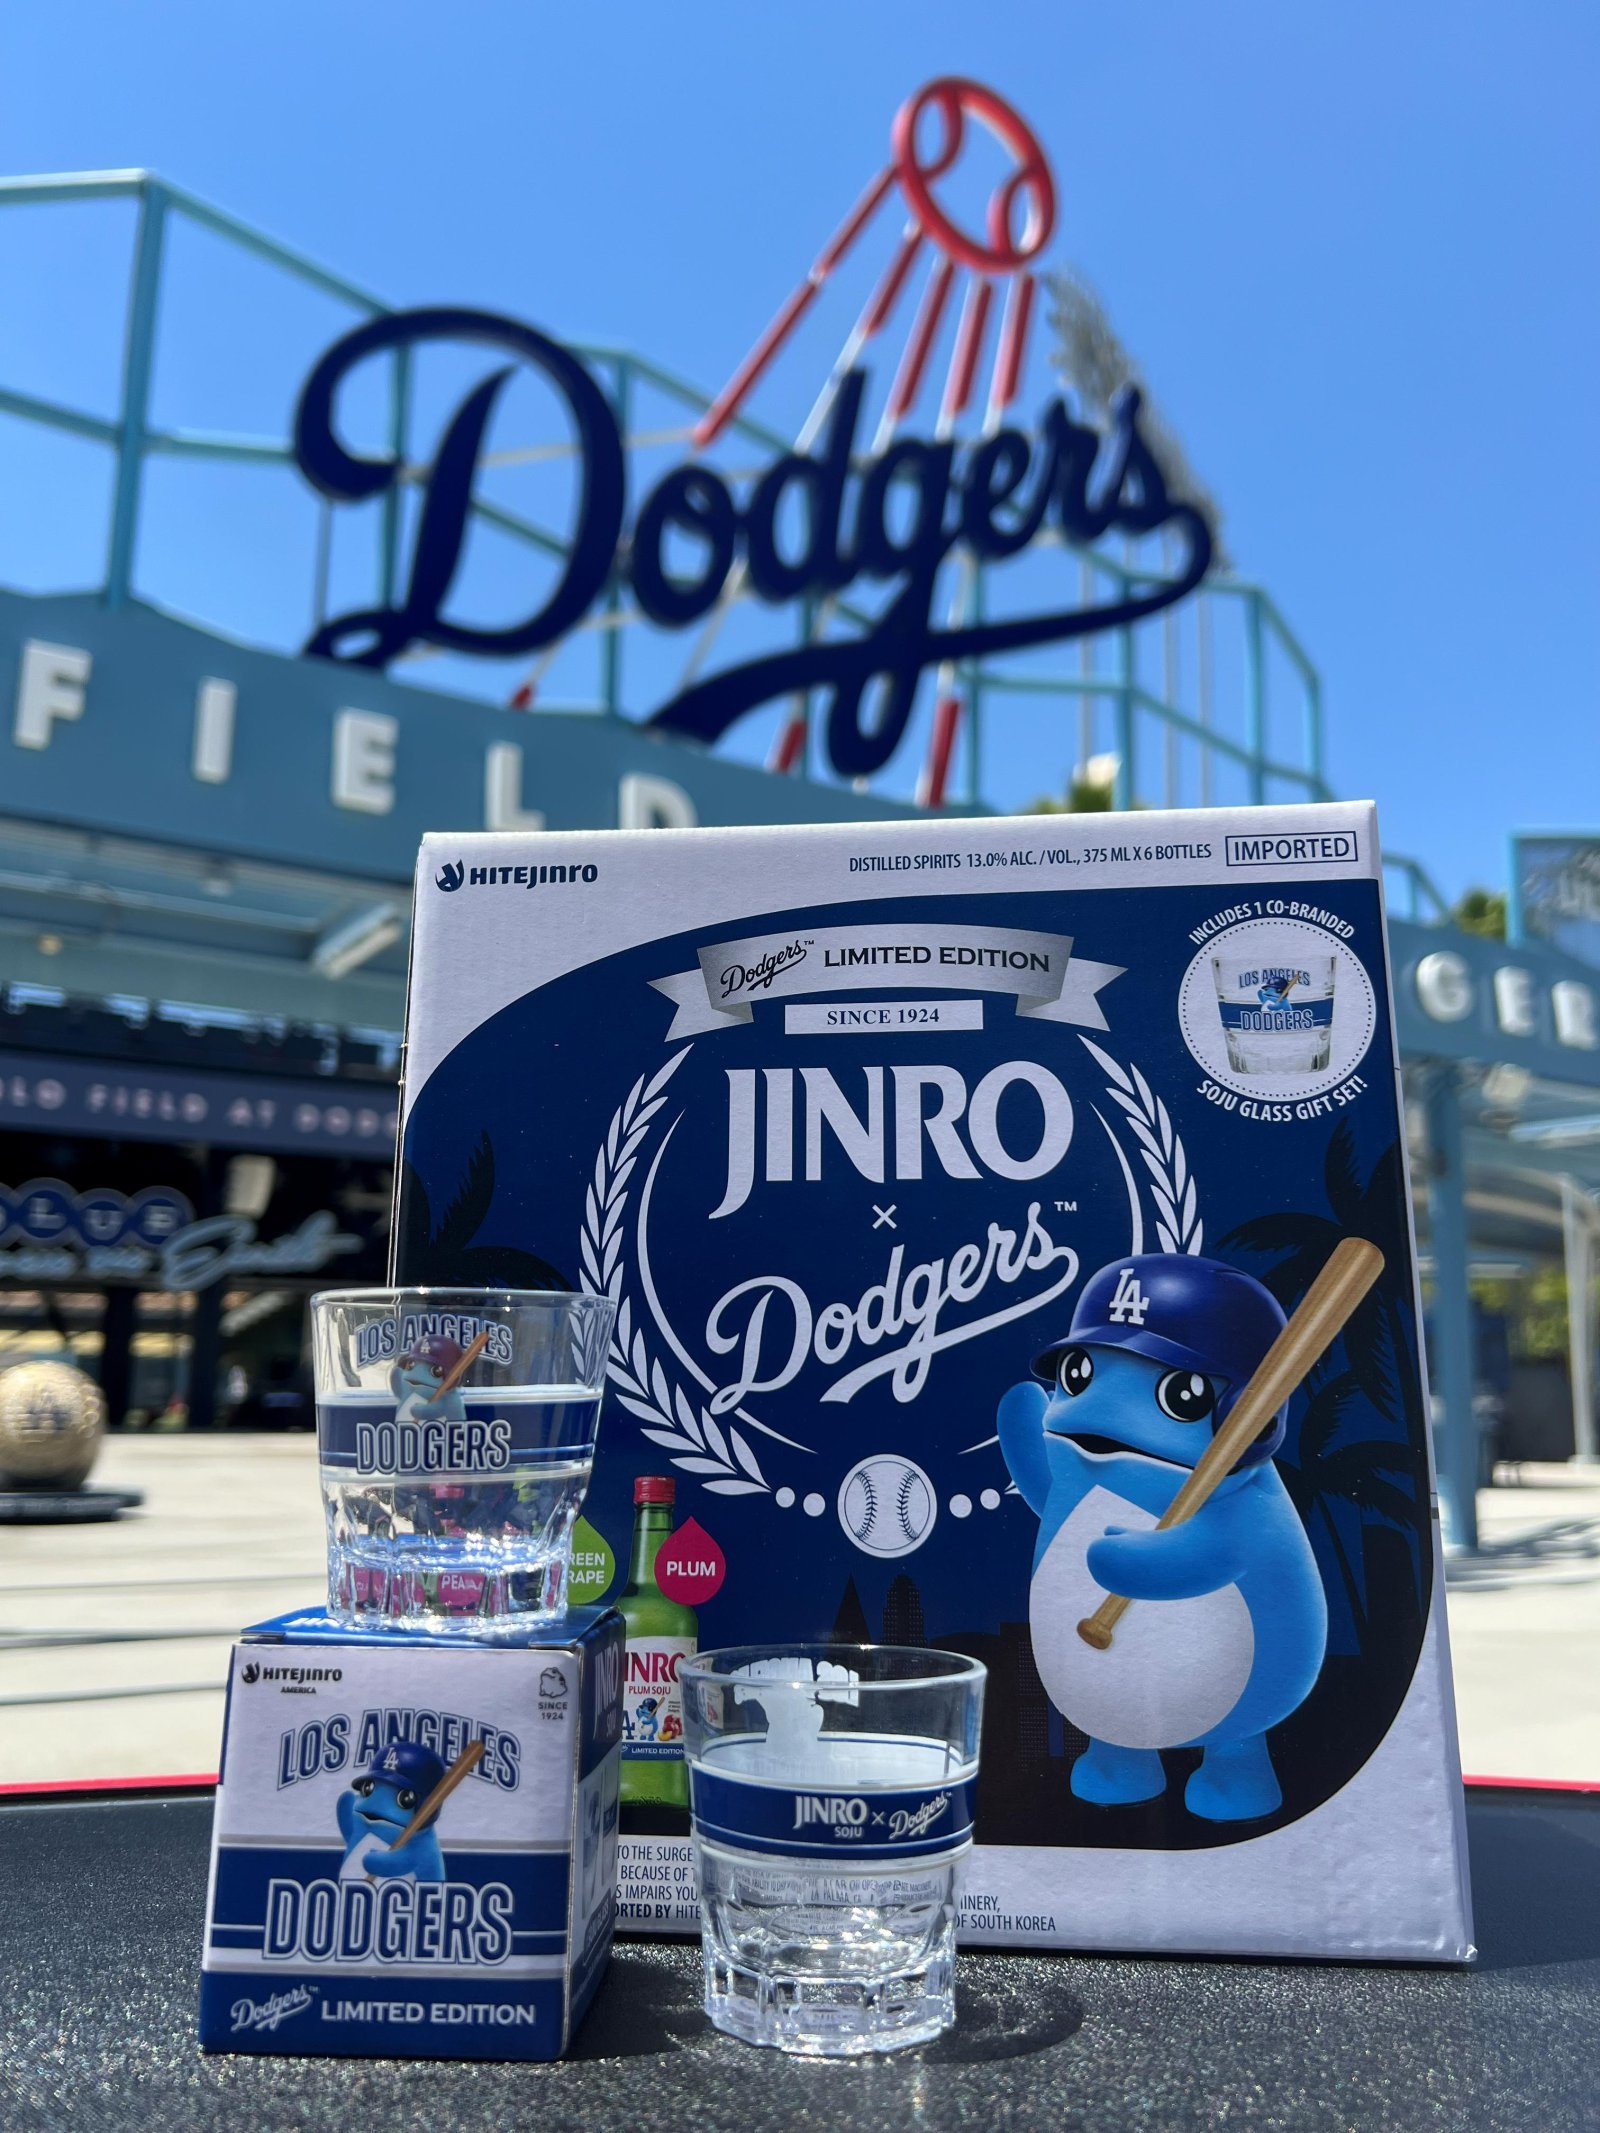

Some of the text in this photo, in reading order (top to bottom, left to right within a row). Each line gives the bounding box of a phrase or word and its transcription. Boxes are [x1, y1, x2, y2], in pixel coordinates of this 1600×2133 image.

[294, 304, 1212, 778] Dodgers
[14, 638, 698, 831] FIELD
[850, 855, 911, 872] DISTILLED
[913, 853, 961, 869] SPIRITS
[967, 852, 1008, 868] 13.0%
[1083, 848, 1108, 863] 375
[1110, 847, 1131, 862] ML
[1133, 846, 1142, 861] X
[1144, 846, 1153, 860] 6
[1155, 844, 1212, 860] BOTTLES
[1234, 837, 1350, 861] IMPORTED
[1189, 899, 1355, 946] INCLUDES 1 CO-BRANDED
[720, 938, 807, 999] Dodgers
[824, 946, 931, 968] LIMITED
[939, 946, 1050, 973] EDITION
[1239, 969, 1259, 989] LOS
[827, 1008, 940, 1026] SINCE 1924
[1240, 1009, 1314, 1032] DODGERS
[87, 1083, 208, 1123] FIELD
[227, 1096, 276, 1129] AT
[1197, 1075, 1368, 1122] SOJU GLASS GIFT SET!
[709, 1061, 1074, 1220] JINRO
[706, 1202, 1080, 1415] Dodgers
[1109, 1268, 1150, 1325] LA
[355, 1318, 397, 1366] LOS
[356, 1419, 512, 1475] DODGERS
[666, 1560, 716, 1577] PLUM
[280, 1686, 317, 1694] AMERICA
[628, 1685, 671, 1695] PLUM SOJU
[538, 1701, 568, 1710] SINCE
[541, 1711, 564, 1720] 1924
[277, 1708, 521, 1791] LOS ANGELES
[793, 1795, 868, 1829] JINRO
[889, 1791, 948, 1840] Dodgers
[834, 1826, 864, 1838] SOJU
[632, 1845, 652, 1860] THE
[621, 1865, 670, 1880] BECAUSE
[674, 1867, 688, 1881] OF
[626, 1884, 672, 1900] IMPAIRS
[262, 1876, 515, 1965] DODGERS
[655, 1904, 671, 1918] BY
[971, 1914, 1012, 1930] SOUTH
[1015, 1915, 1056, 1931] KOREA
[230, 1984, 535, 2032] Dodgers LIMITED EDITION
